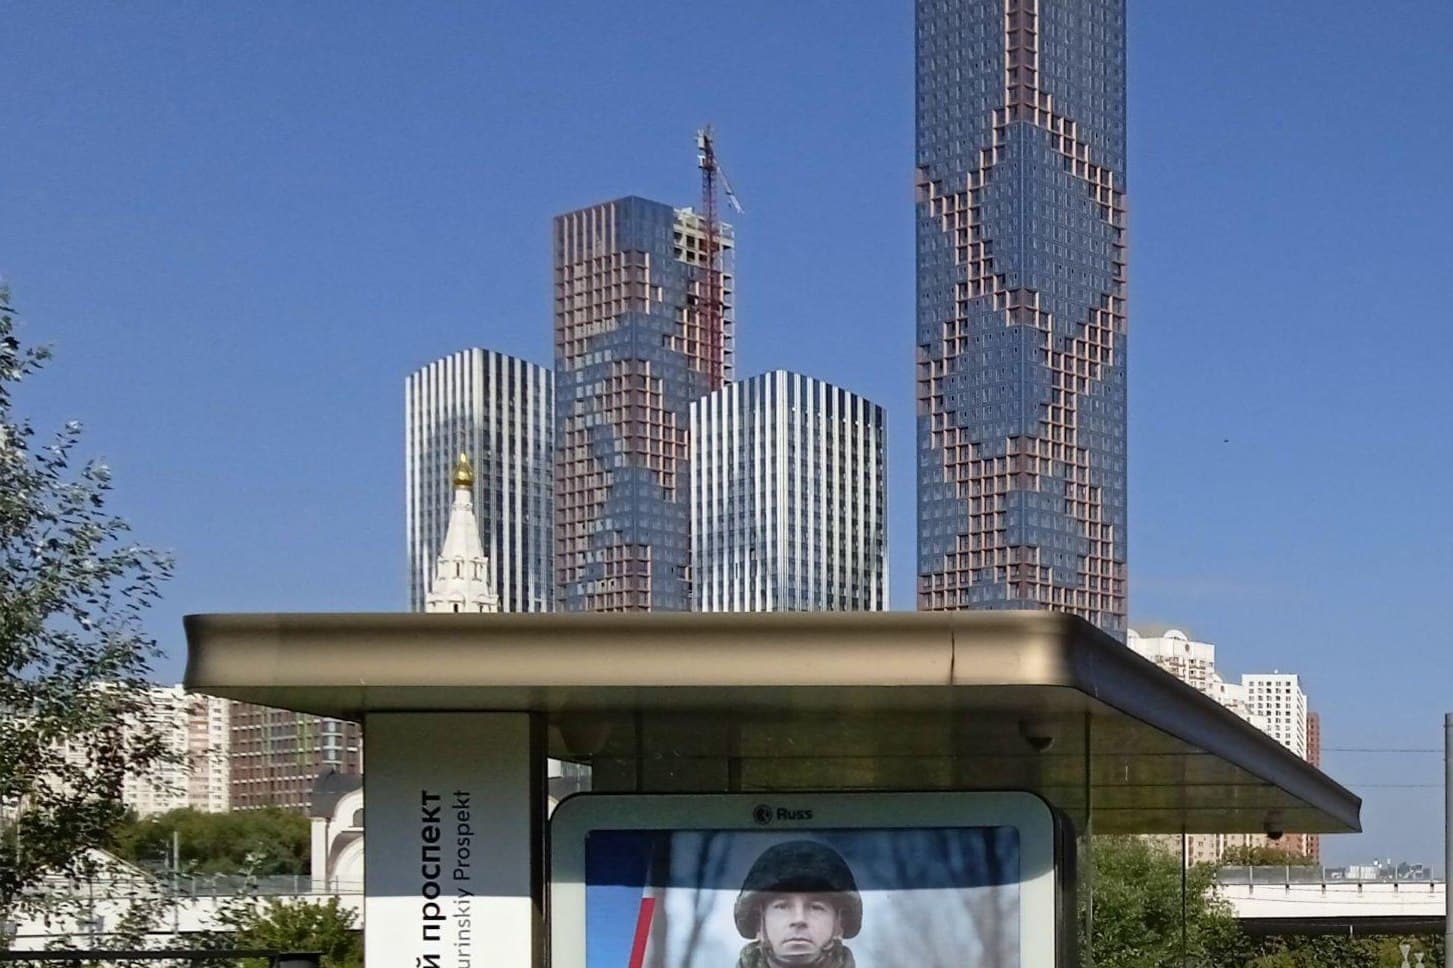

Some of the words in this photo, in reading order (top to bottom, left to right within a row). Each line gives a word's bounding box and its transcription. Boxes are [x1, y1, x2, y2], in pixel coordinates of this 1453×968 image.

[452, 789, 475, 881] Prospekt
[776, 807, 813, 820] Russ
[420, 790, 447, 942] проспект
